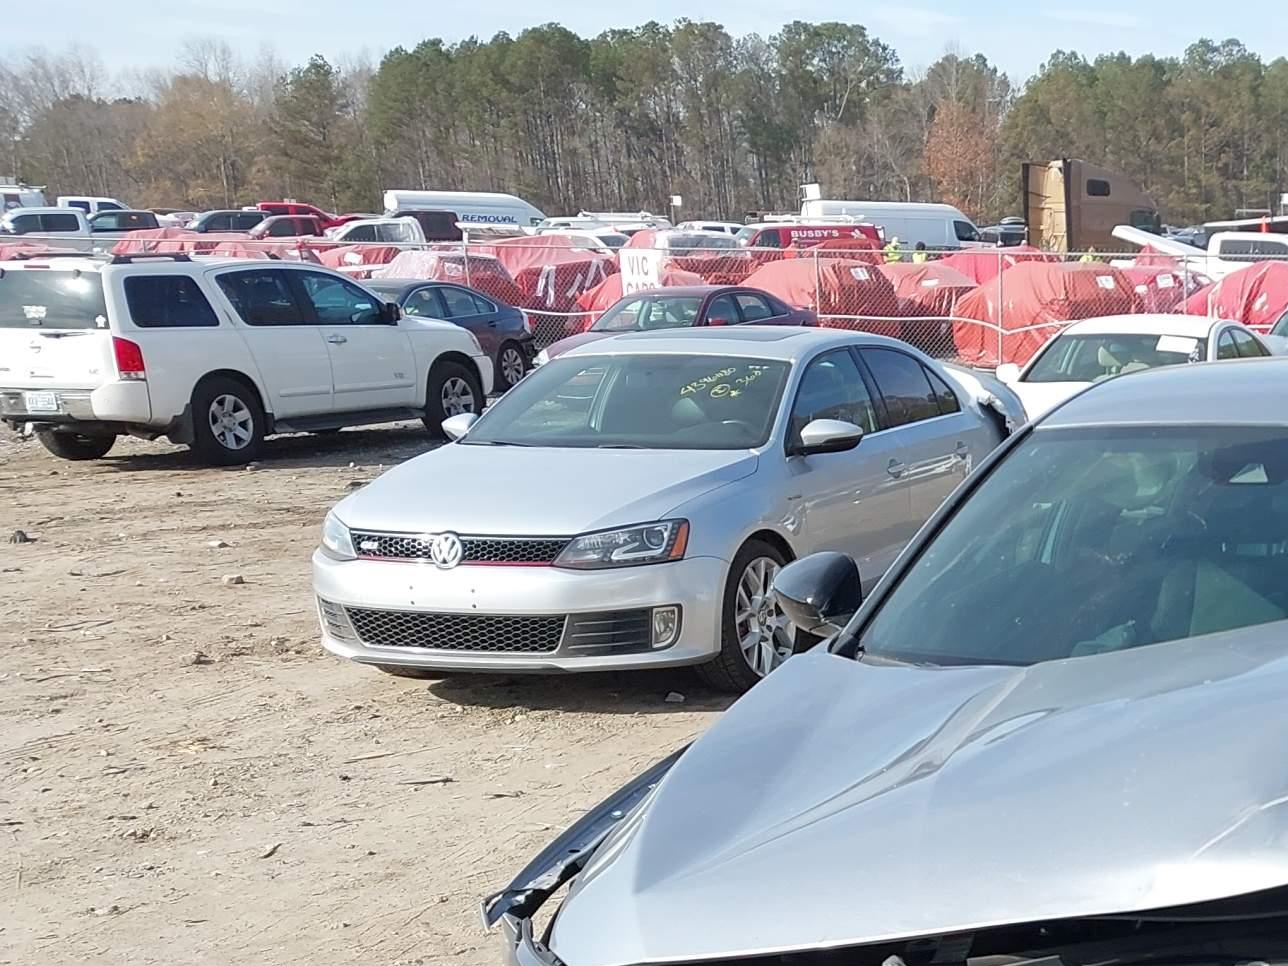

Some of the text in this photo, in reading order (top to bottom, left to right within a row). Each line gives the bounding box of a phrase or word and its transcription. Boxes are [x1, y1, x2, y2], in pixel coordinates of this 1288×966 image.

[462, 214, 517, 224] REMOVAL
[790, 229, 840, 238] BUSBY'S
[627, 255, 649, 276] VIC
